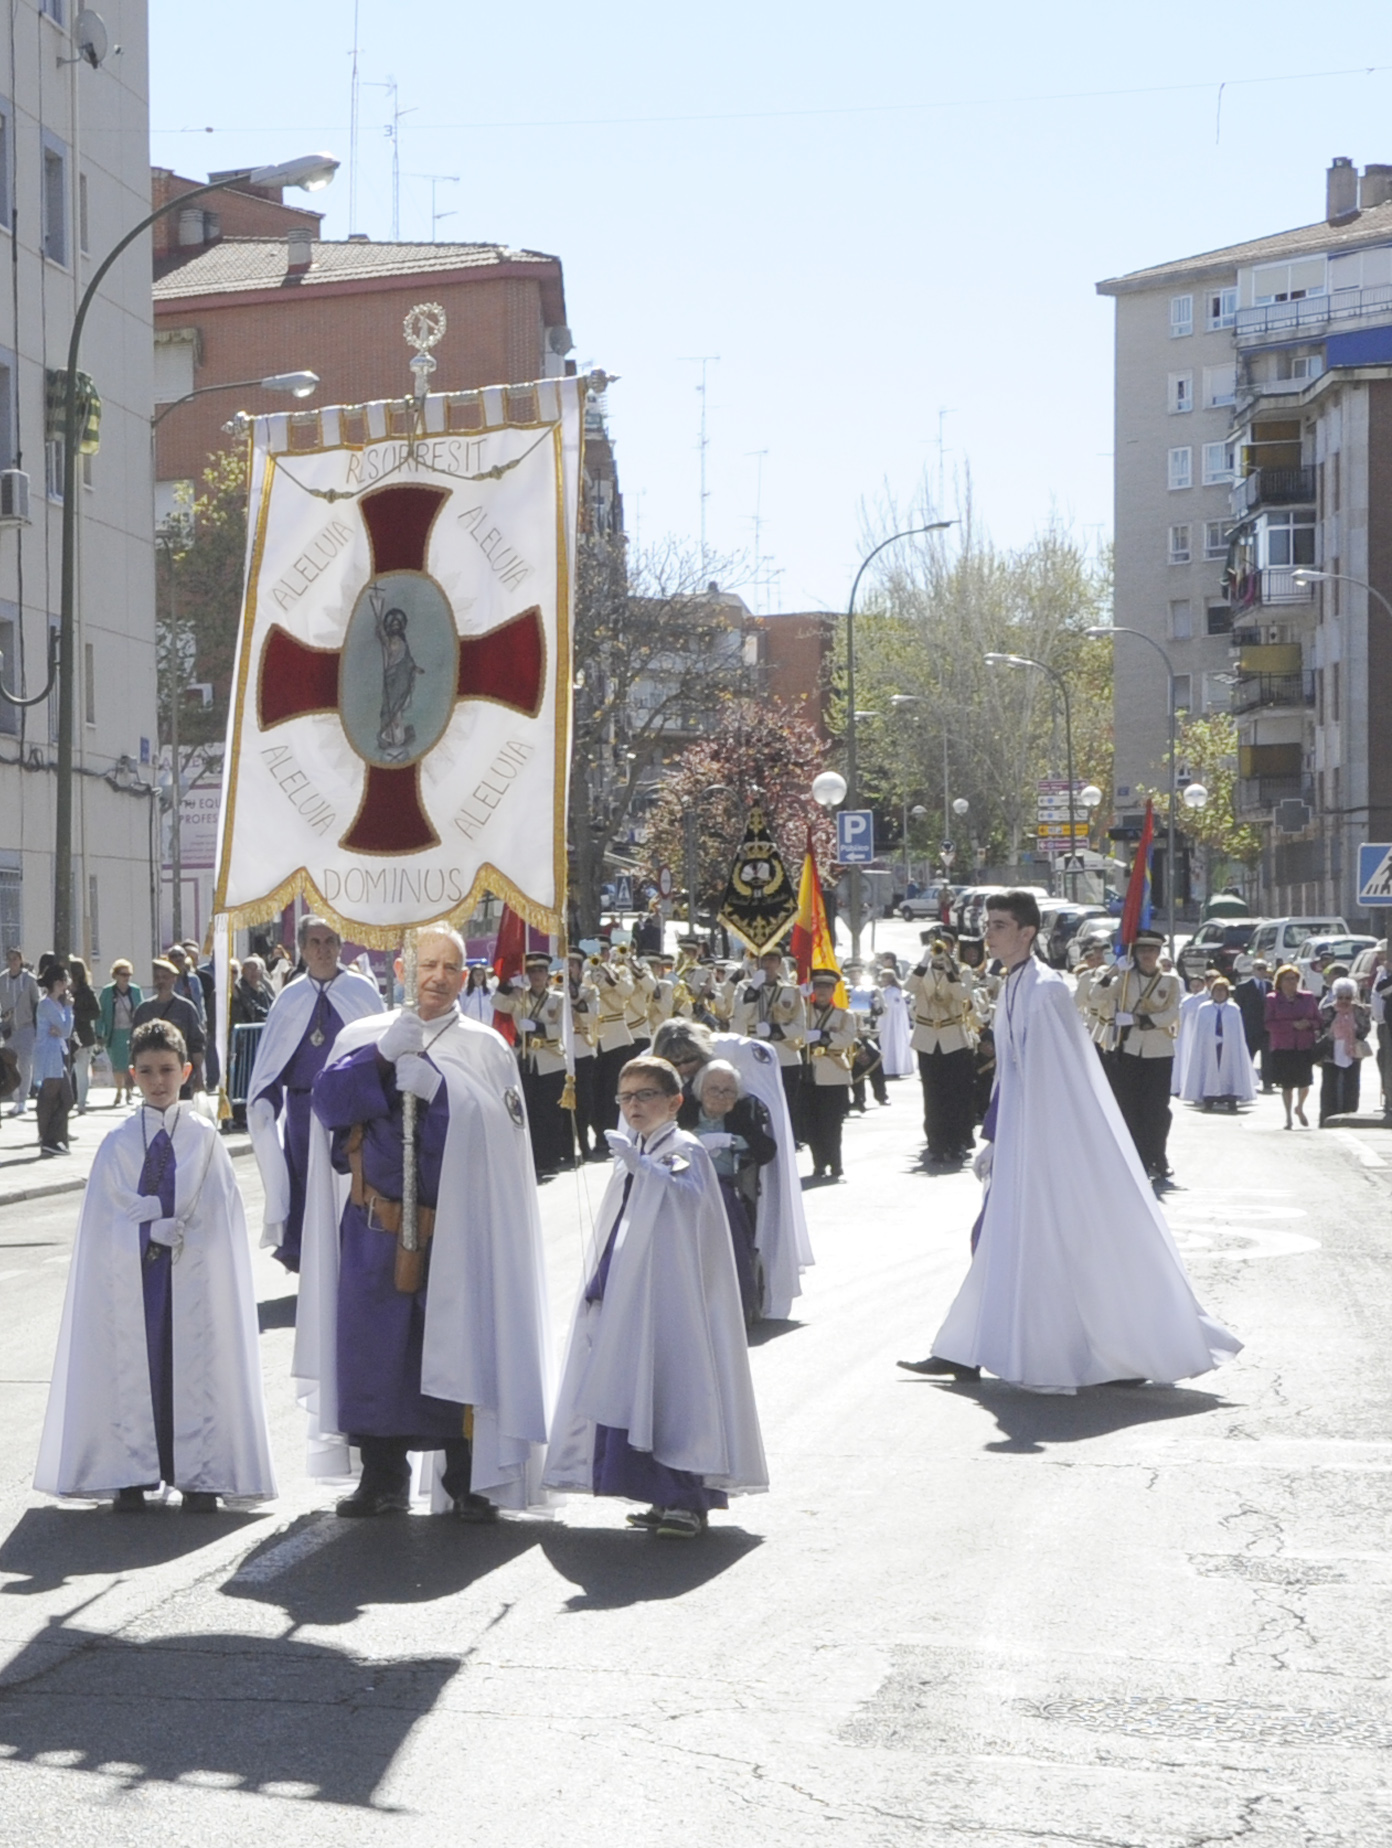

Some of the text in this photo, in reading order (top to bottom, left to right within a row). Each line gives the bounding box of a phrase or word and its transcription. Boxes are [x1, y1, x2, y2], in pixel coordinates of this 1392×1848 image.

[272, 521, 354, 611] ALELUIA
[457, 505, 528, 593] ALELUIA
[260, 745, 336, 837] ALELUIA
[454, 740, 534, 840] ALELUIA
[844, 815, 867, 843] P
[324, 867, 463, 903] DOMINUS
